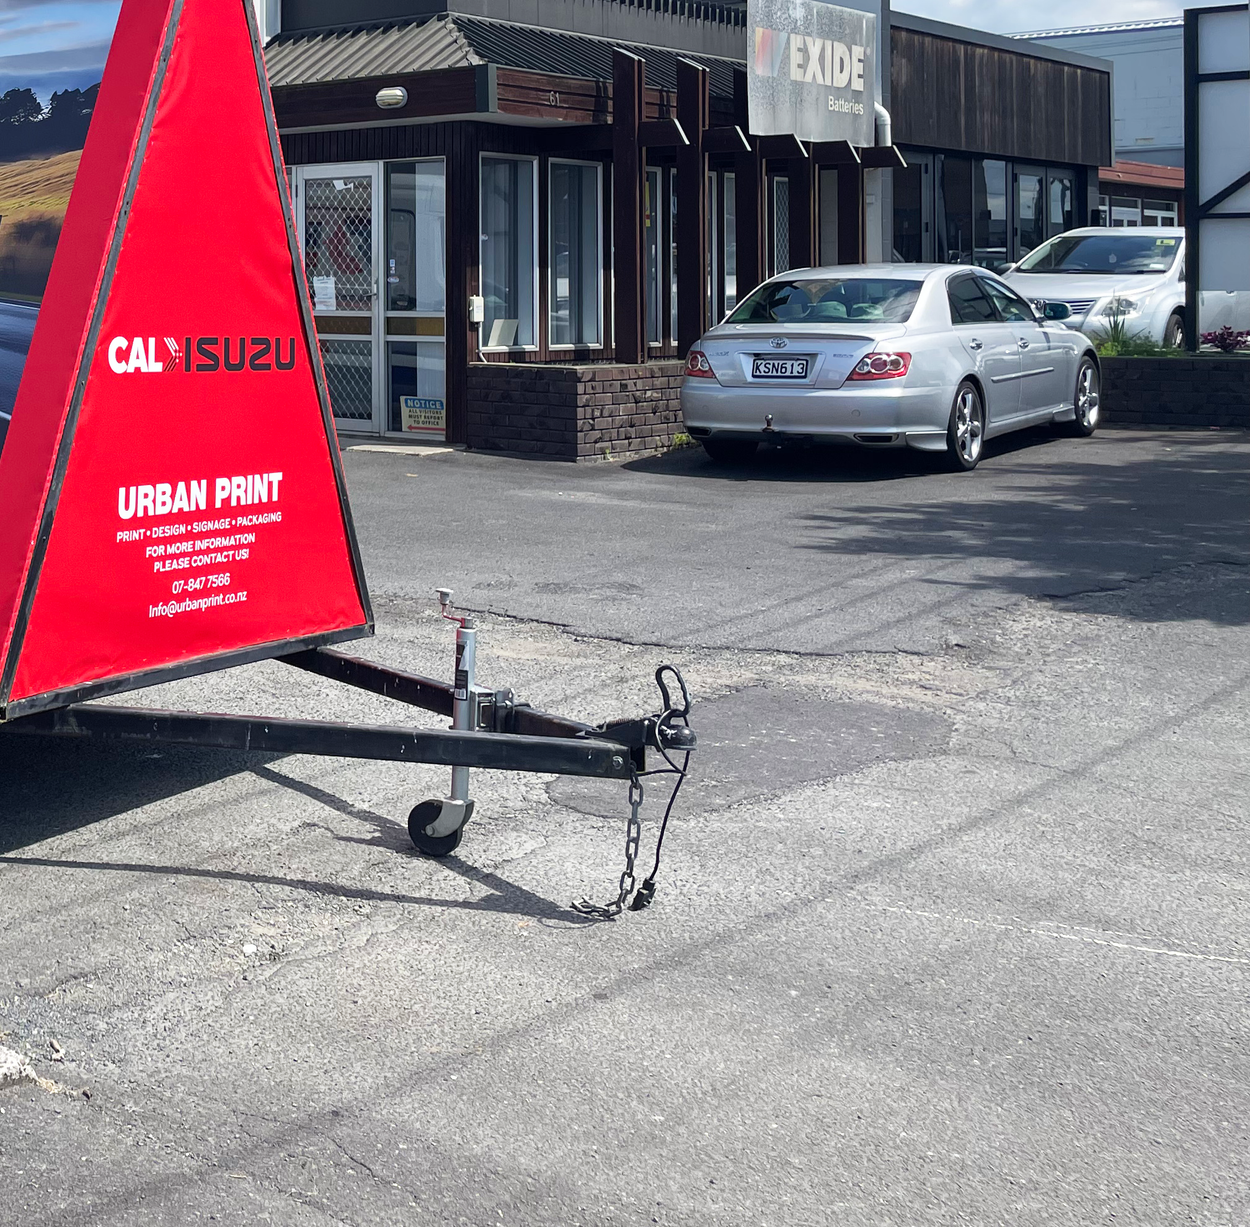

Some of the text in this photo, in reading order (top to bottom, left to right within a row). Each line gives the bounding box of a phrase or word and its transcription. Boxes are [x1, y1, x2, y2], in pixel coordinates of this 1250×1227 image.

[790, 33, 864, 92] EXIDE
[550, 91, 559, 106] 61
[828, 95, 864, 115] Batteries
[108, 336, 296, 374] CAL ISUZU
[754, 362, 805, 375] KSN613
[407, 399, 442, 409] NOTICE
[118, 472, 283, 520] URBAN PRINT
[116, 512, 282, 542] PRINT DESIGN SIGNAGE PACKAGING
[146, 532, 256, 558] FOR MORE INFORMATION
[154, 548, 250, 572] PLEASE CONTACT US!
[172, 572, 230, 594] 07-847 7566
[148, 590, 248, 618] Info@urbanprint.co.nz
